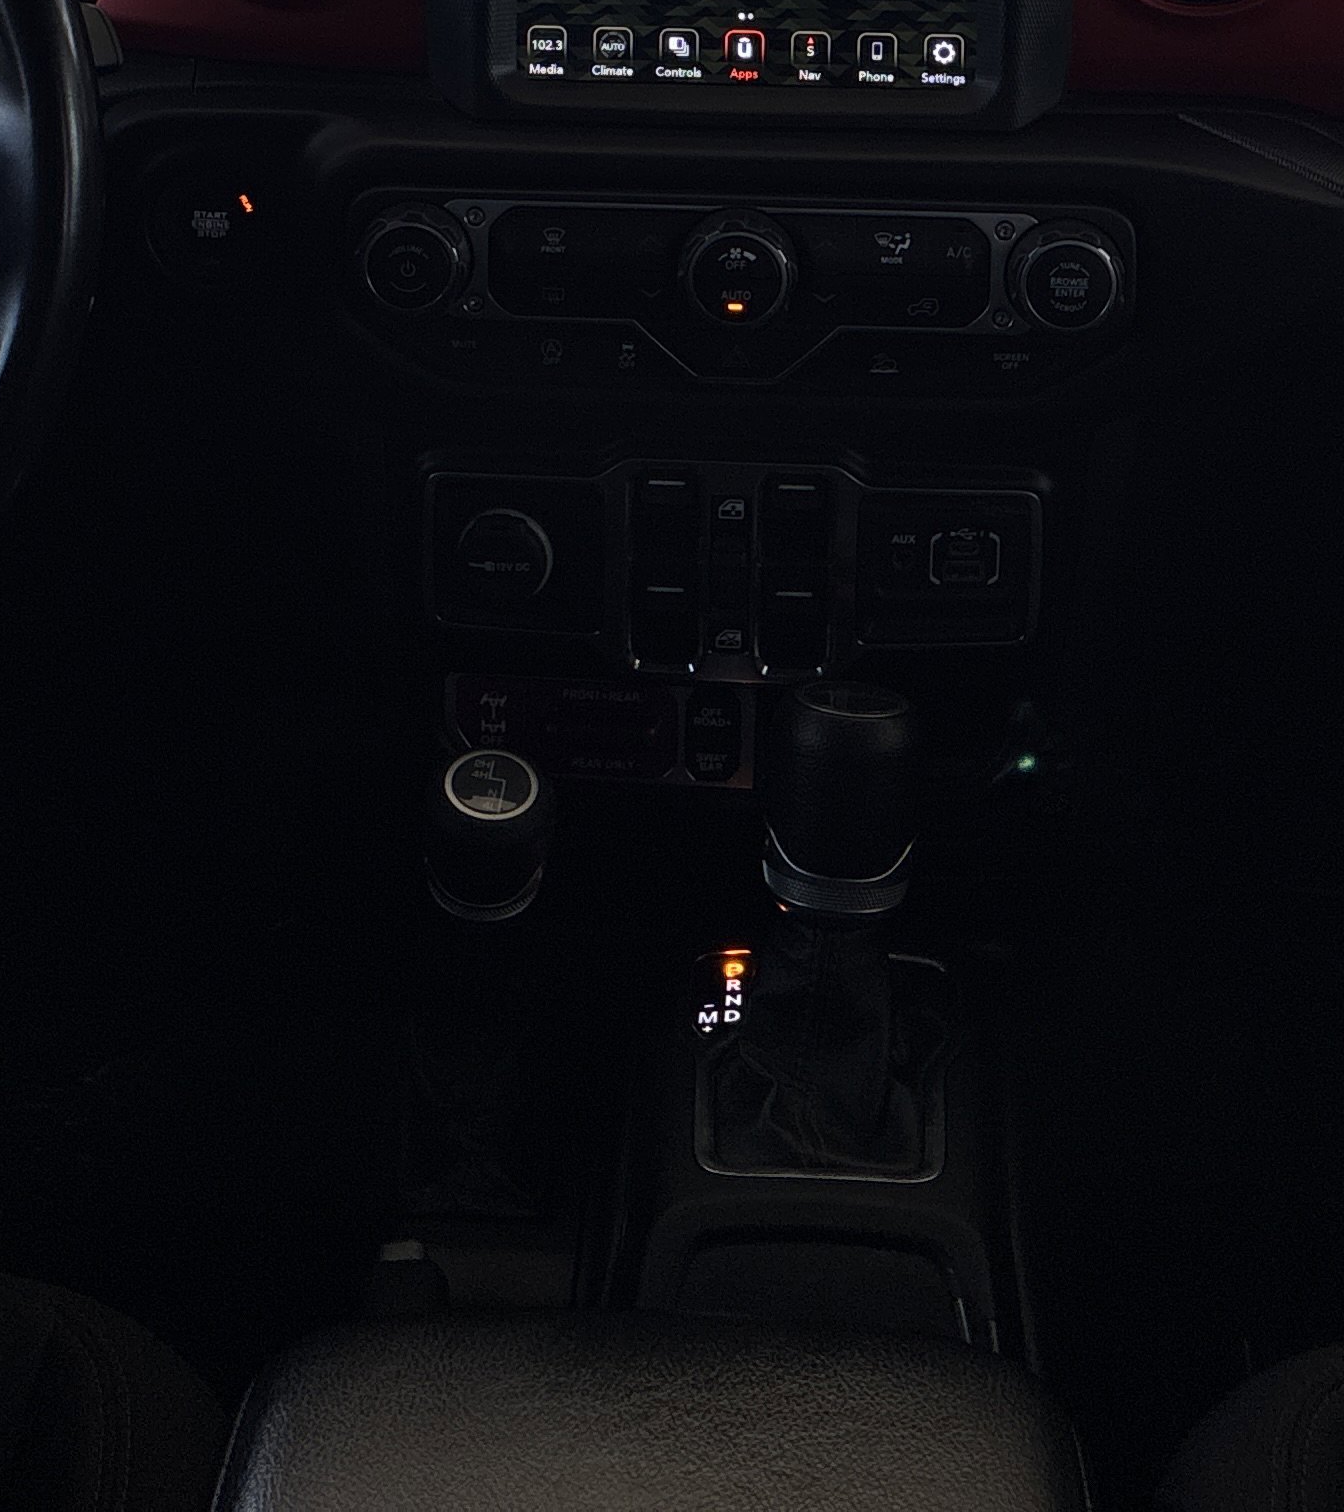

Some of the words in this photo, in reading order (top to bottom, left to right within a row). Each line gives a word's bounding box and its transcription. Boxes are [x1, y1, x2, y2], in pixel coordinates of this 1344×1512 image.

[532, 40, 562, 50] 102.3
[602, 42, 625, 51] AUTO
[529, 64, 563, 74] Media
[592, 65, 633, 76] Climate
[656, 66, 701, 77] Controls
[730, 68, 758, 81] Apps
[799, 70, 821, 80] Nav
[859, 71, 894, 82] Phone
[922, 72, 965, 86] Settings
[193, 210, 228, 219] START
[539, 245, 567, 254] FRONT
[947, 246, 972, 259] A/C
[725, 260, 747, 271] OFF
[880, 256, 904, 265] MODE
[1050, 277, 1089, 287] BROWSE
[720, 290, 752, 300] AUTO
[1054, 288, 1087, 297] ENTER
[891, 534, 917, 545] AUX
[725, 963, 744, 978] P
[726, 979, 741, 991] R
[725, 994, 742, 1006] N
[698, 1011, 719, 1024] M
[724, 1010, 741, 1023] D
